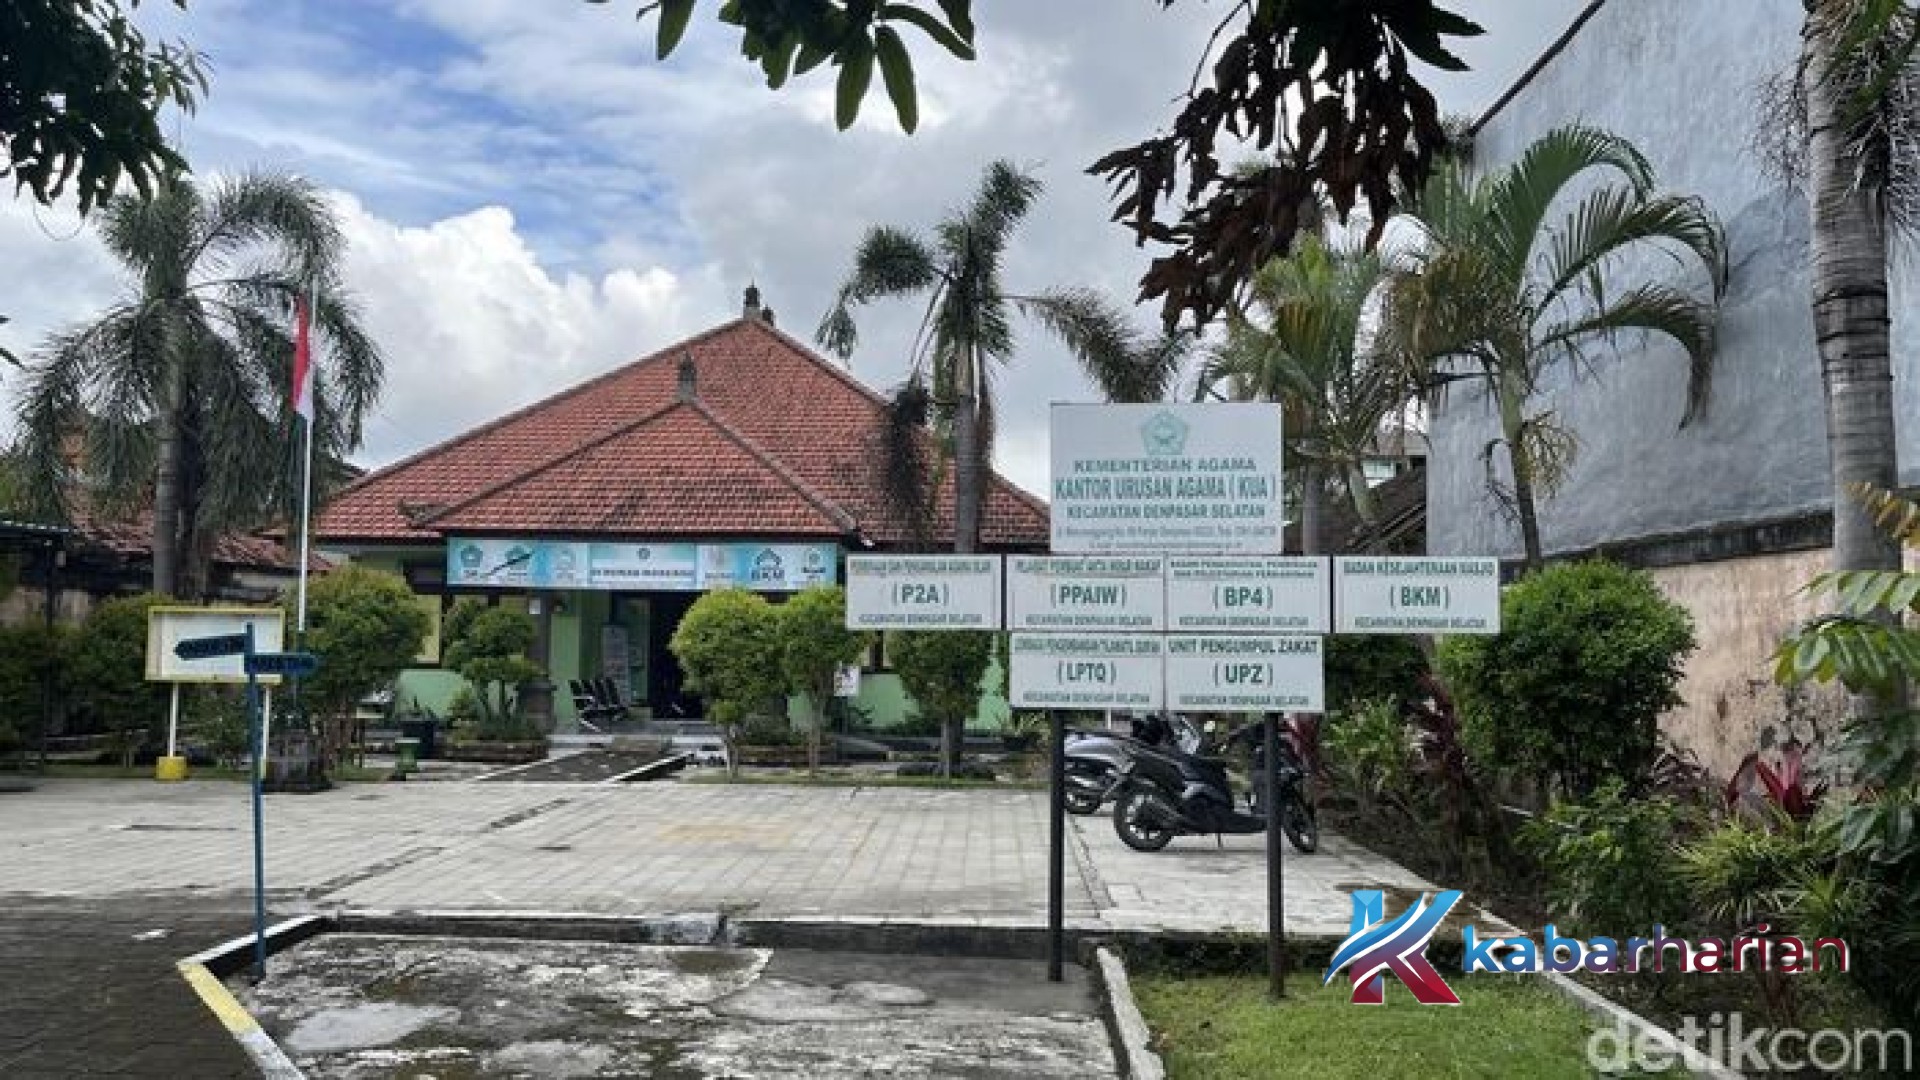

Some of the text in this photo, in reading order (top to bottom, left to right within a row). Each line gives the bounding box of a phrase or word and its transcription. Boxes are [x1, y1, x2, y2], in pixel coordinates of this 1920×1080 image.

[1074, 459, 1257, 472] KEMENTERIAN AGAMA
[1055, 476, 1112, 498] KANTOR
[1115, 476, 1172, 498] URUSAN
[1176, 476, 1227, 498] AGAMA
[1066, 504, 1265, 518] KECAMATAN DENPASAR SELATAN
